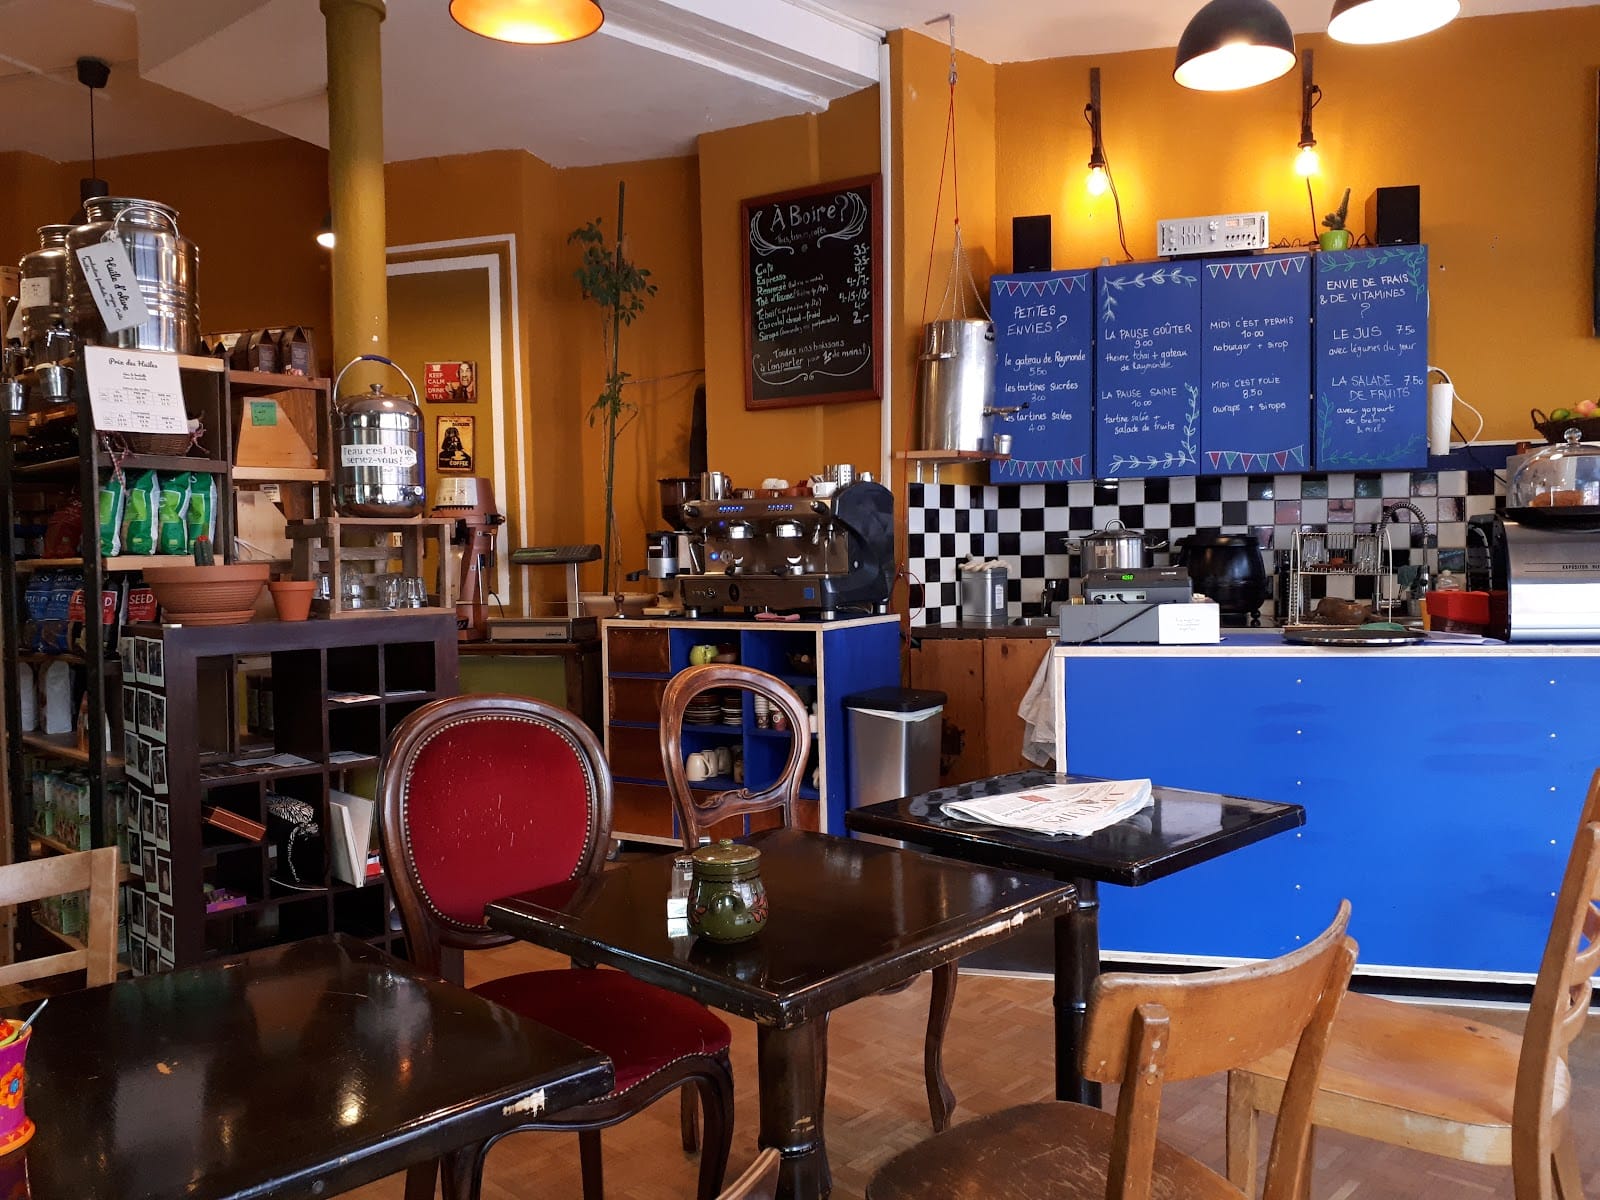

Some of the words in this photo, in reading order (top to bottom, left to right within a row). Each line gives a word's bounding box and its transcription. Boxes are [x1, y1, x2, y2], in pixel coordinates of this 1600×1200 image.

[770, 204, 786, 232] À
[789, 195, 849, 227] Boire?
[104, 256, 121, 283] Huile
[755, 263, 774, 277] Café
[757, 274, 787, 287] Espresso
[1327, 278, 1358, 291] ENVIE
[1362, 277, 1377, 288] DE
[1381, 273, 1409, 286] FRAIS
[1320, 294, 1328, 305] &
[1330, 293, 1348, 304] DE
[1351, 288, 1406, 301] VITAMINES
[1014, 304, 1056, 319] PETITES
[1360, 302, 1371, 319] ?
[1007, 321, 1053, 336] ENVIES
[1210, 321, 1231, 330] MIDI
[1235, 316, 1260, 329] C'EST
[1263, 316, 1295, 327] PERMIS
[1104, 328, 1116, 341] LA
[1119, 328, 1150, 340] PAUSE
[1152, 321, 1193, 336] GOÛTER
[1333, 329, 1350, 340] LE
[1353, 326, 1383, 340] JUS
[1328, 346, 1348, 356] avec
[1383, 340, 1396, 352] du
[1398, 342, 1417, 357] jour
[1004, 352, 1012, 367] le
[1043, 352, 1053, 364] de
[1120, 363, 1130, 372] de
[1005, 382, 1016, 393] les
[1017, 381, 1046, 392] tartines
[1050, 379, 1079, 392] sucrées
[1211, 380, 1230, 390] MIDI
[1331, 376, 1347, 387] LA
[1351, 374, 1394, 388] SALADE
[1101, 390, 1113, 400] LA
[1116, 389, 1142, 399] PAUSE
[1149, 386, 1178, 397] SAINE
[1349, 390, 1368, 402] DE
[1370, 387, 1410, 401] FRUITS
[1141, 424, 1150, 432] de
[1153, 420, 1175, 431] fruits
[1345, 416, 1357, 425] de
[366, 446, 386, 456] c'est
[390, 446, 398, 456] la
[399, 446, 412, 456] vie
[449, 460, 469, 468] COFFEE
[128, 593, 154, 604] SEED
